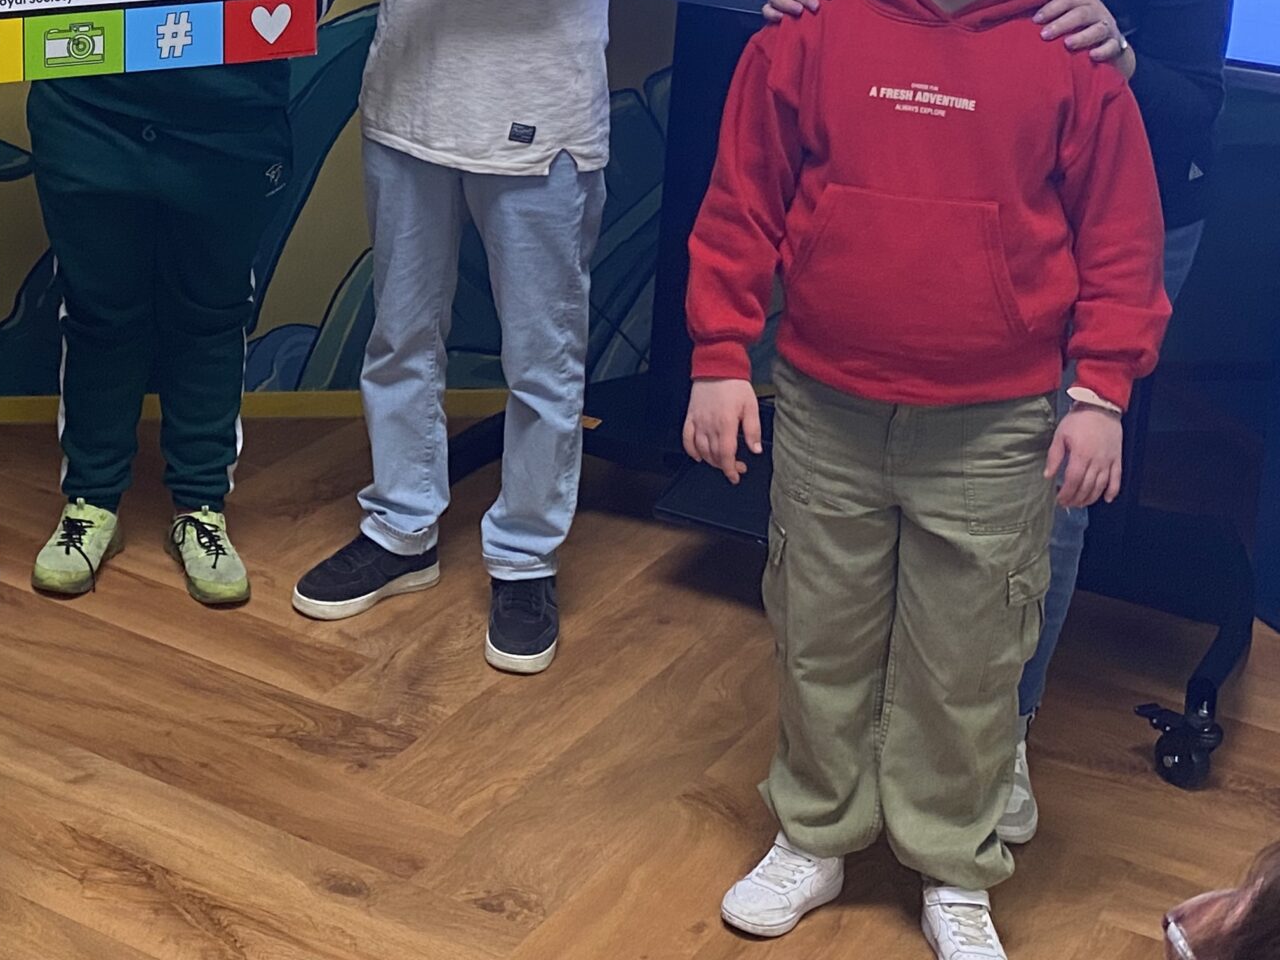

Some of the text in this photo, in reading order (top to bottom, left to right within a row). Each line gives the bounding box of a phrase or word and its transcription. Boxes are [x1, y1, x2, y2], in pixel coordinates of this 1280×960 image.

[868, 85, 977, 112] A FRESH ADVENTURE
[894, 103, 919, 114] ALWAYS
